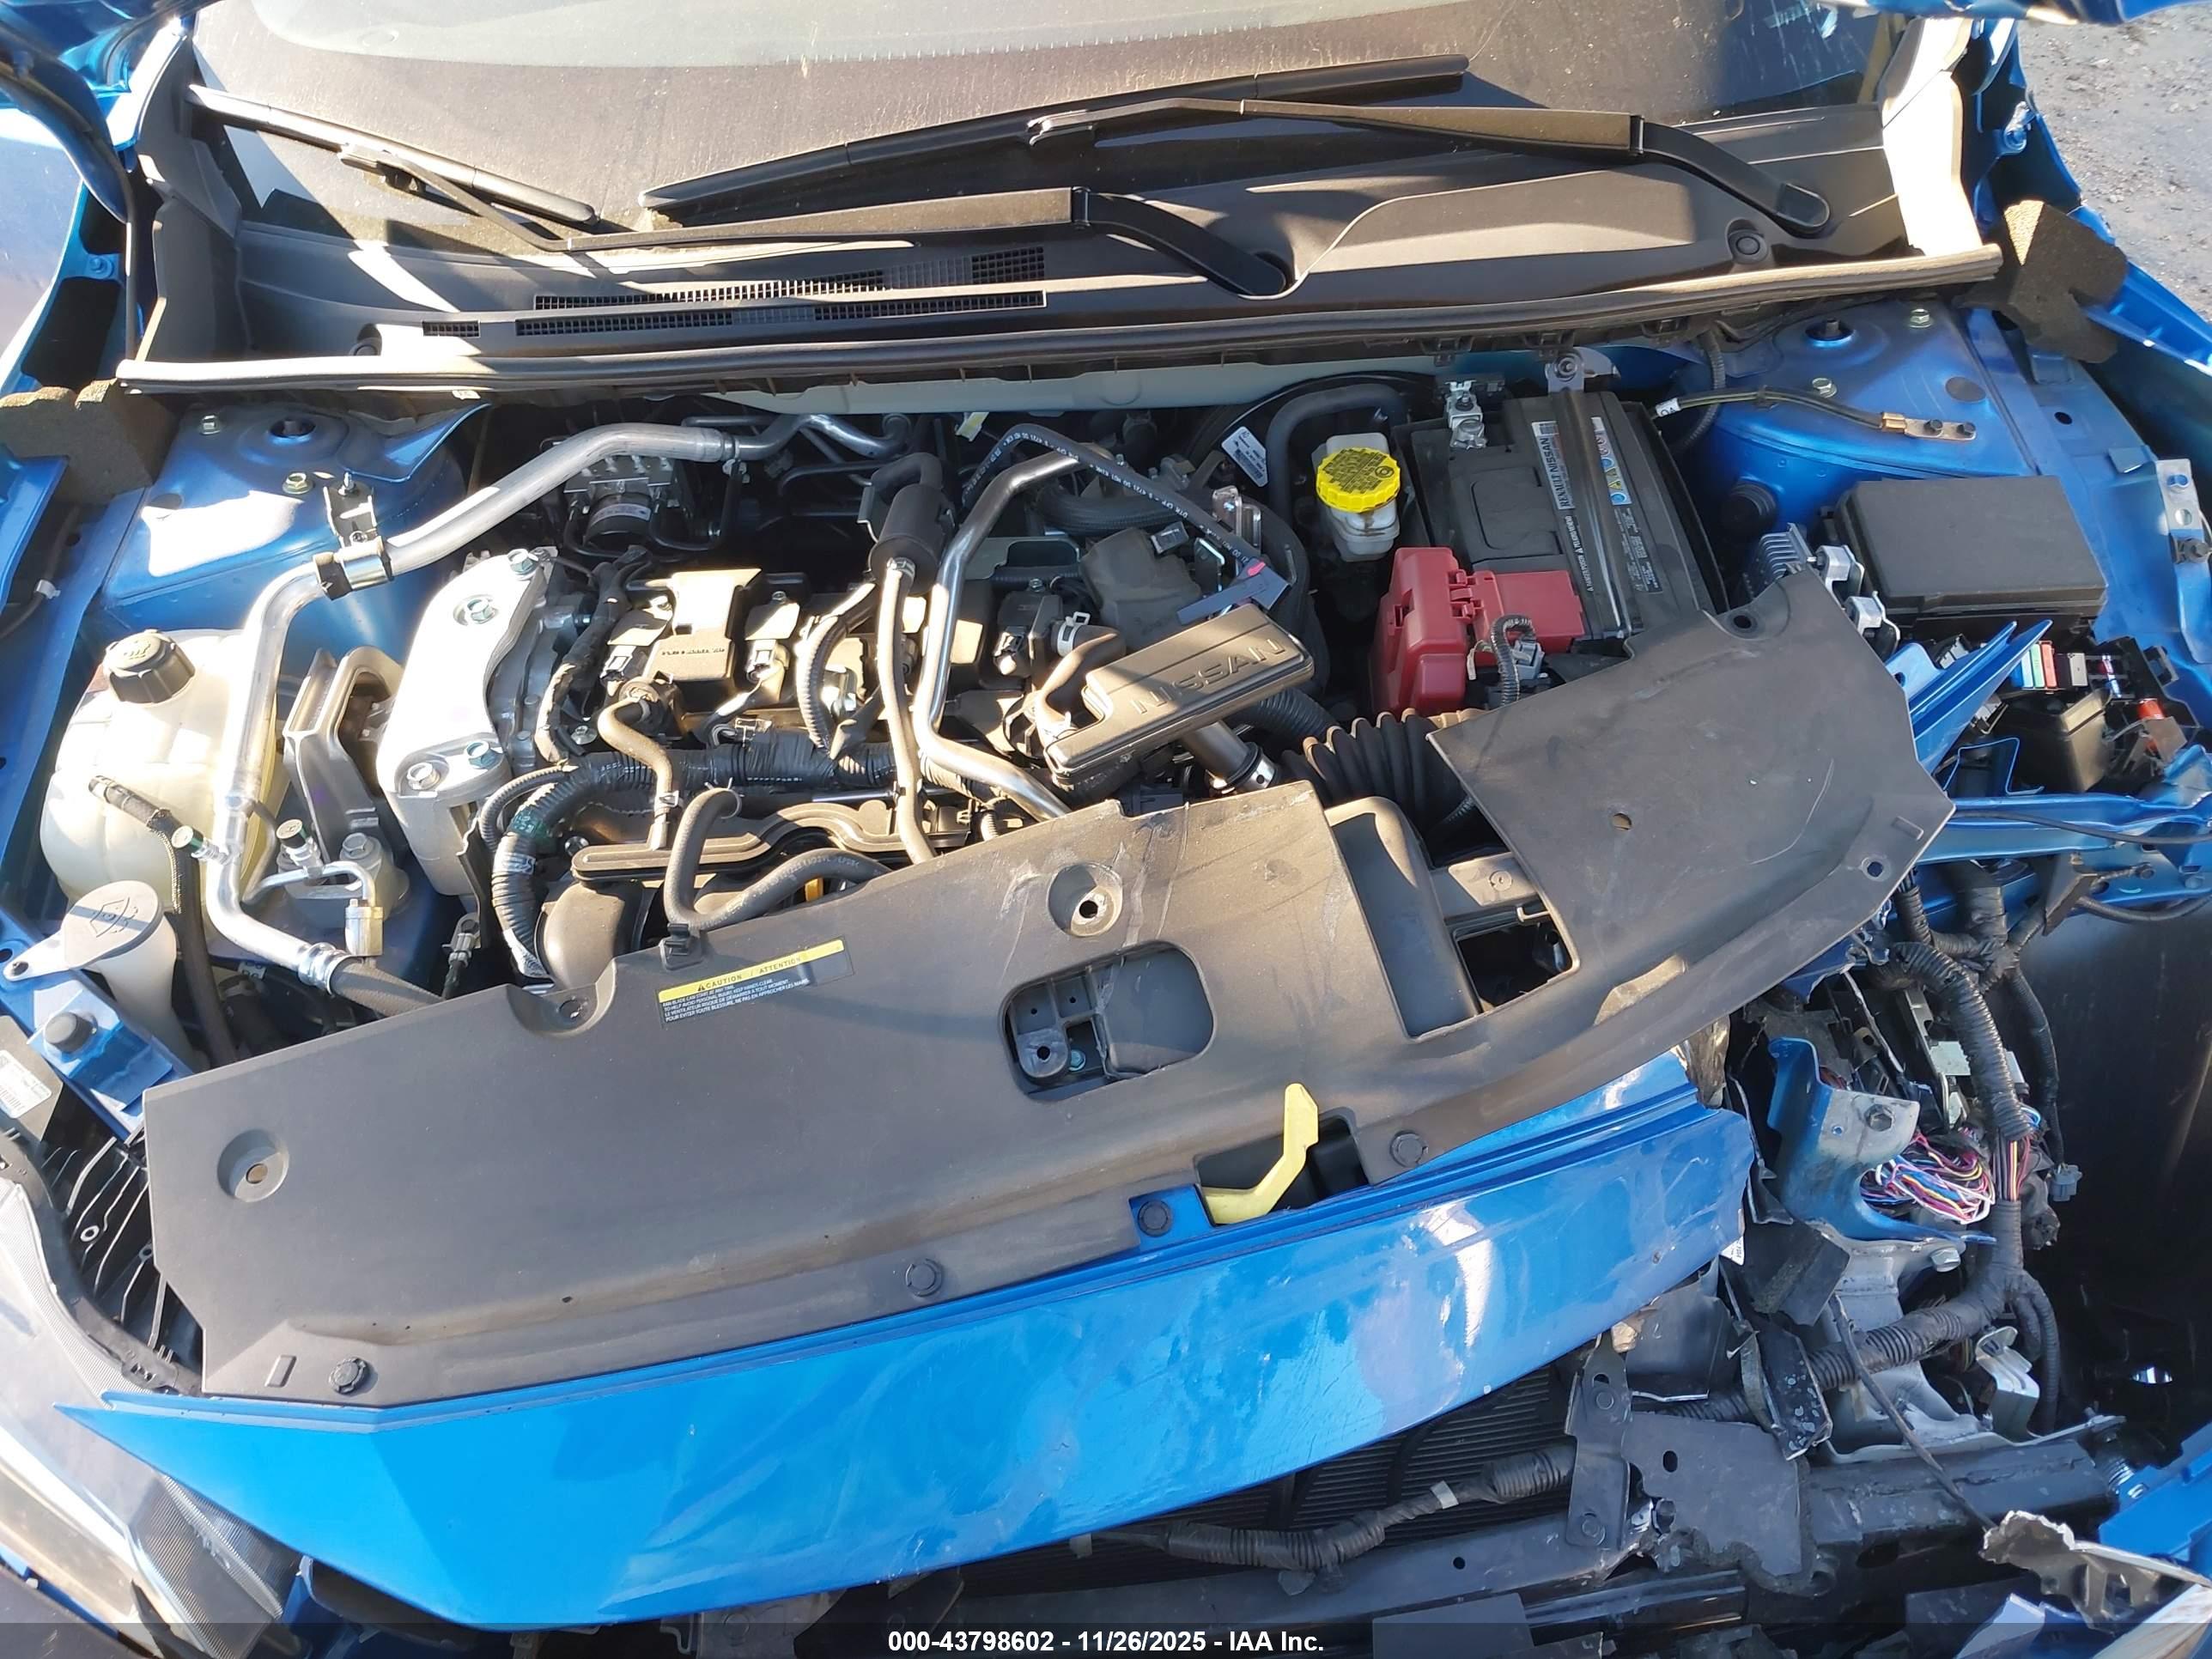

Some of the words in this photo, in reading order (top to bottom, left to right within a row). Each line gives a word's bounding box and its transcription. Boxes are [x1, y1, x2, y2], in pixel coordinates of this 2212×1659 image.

[1540, 437, 1559, 472] NISSAN
[1551, 475, 1571, 507] RENAULT
[1130, 638, 1285, 714] NISSAN
[706, 975, 743, 989] CAUTION
[758, 957, 801, 974] ATTENTION
